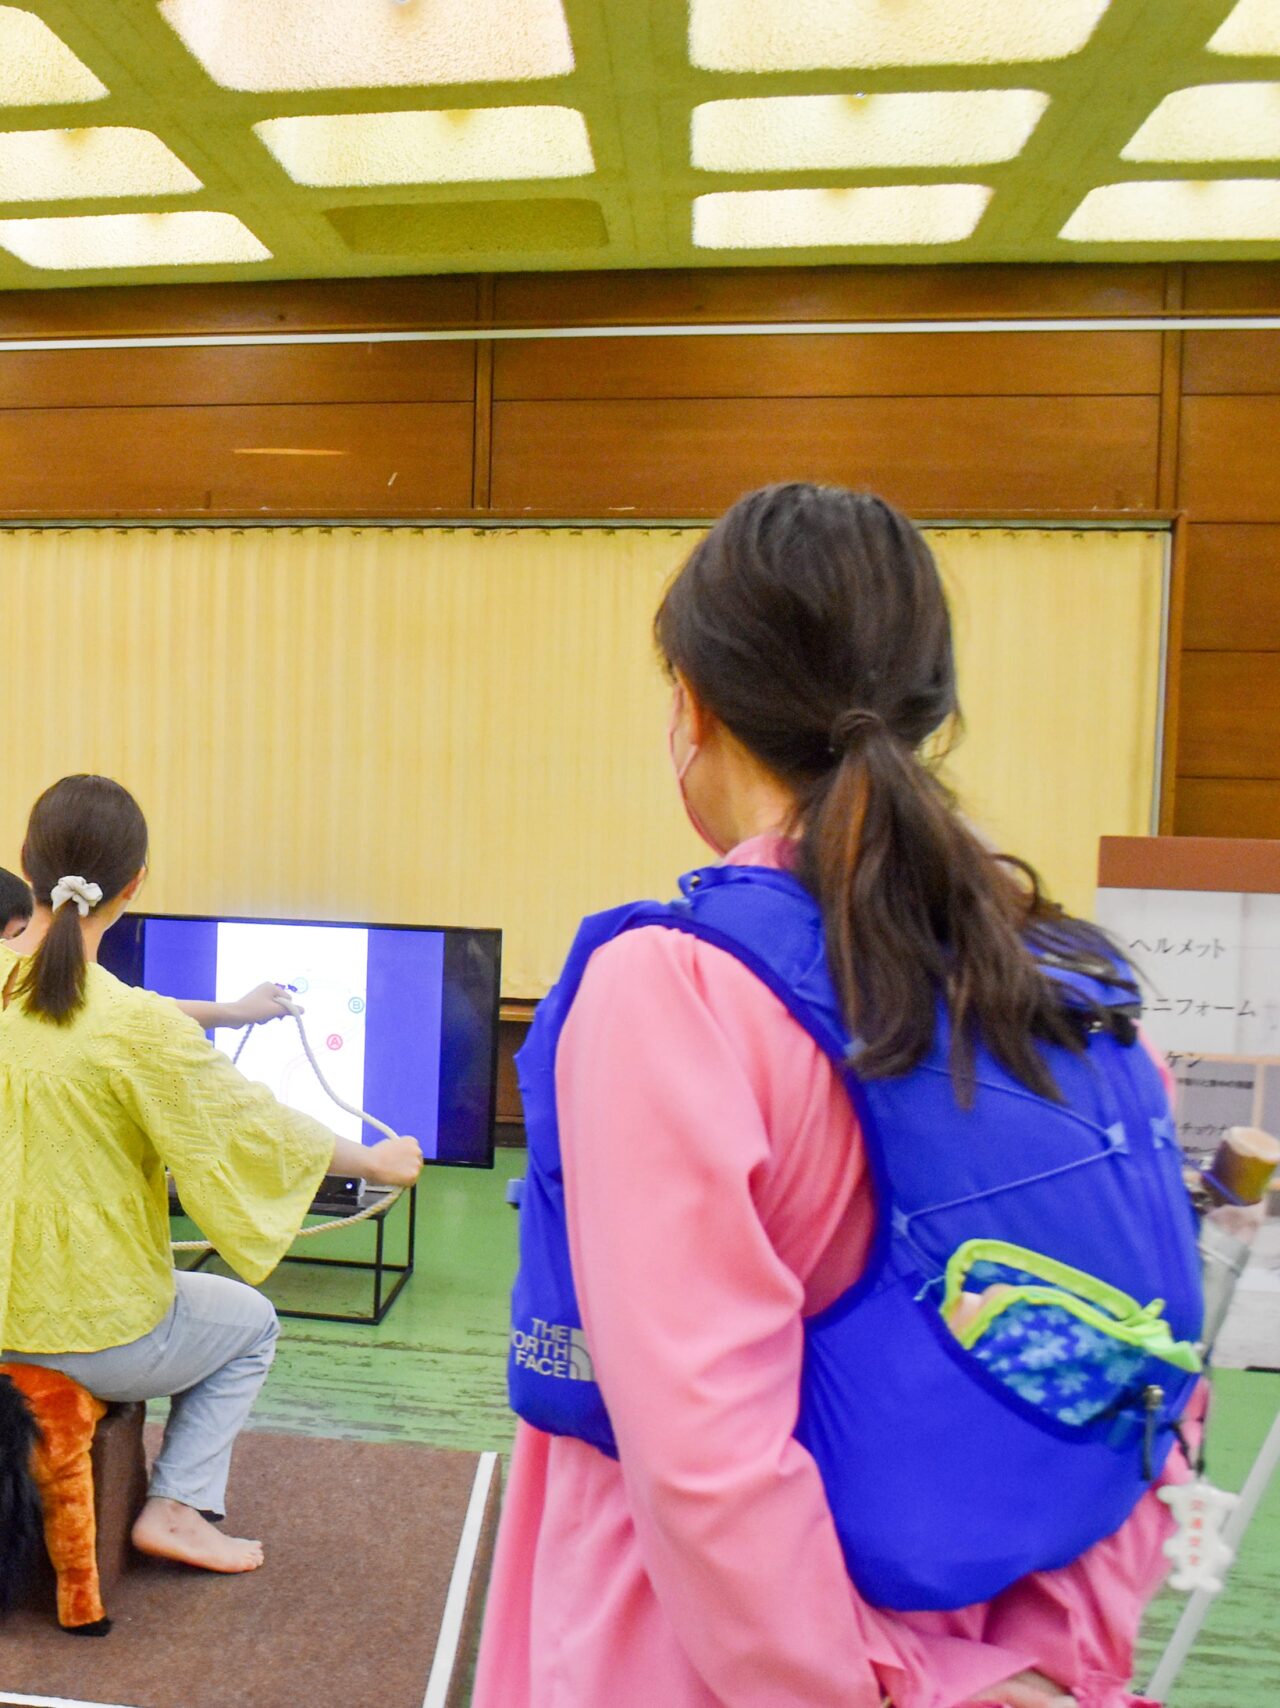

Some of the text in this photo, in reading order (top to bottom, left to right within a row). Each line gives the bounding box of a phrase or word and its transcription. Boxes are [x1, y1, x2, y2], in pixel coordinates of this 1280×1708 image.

[1129, 937, 1226, 960] ヘルメット
[1141, 998, 1257, 1018] ニフォーム
[531, 1317, 568, 1343] THE
[515, 1349, 567, 1379] FACE
